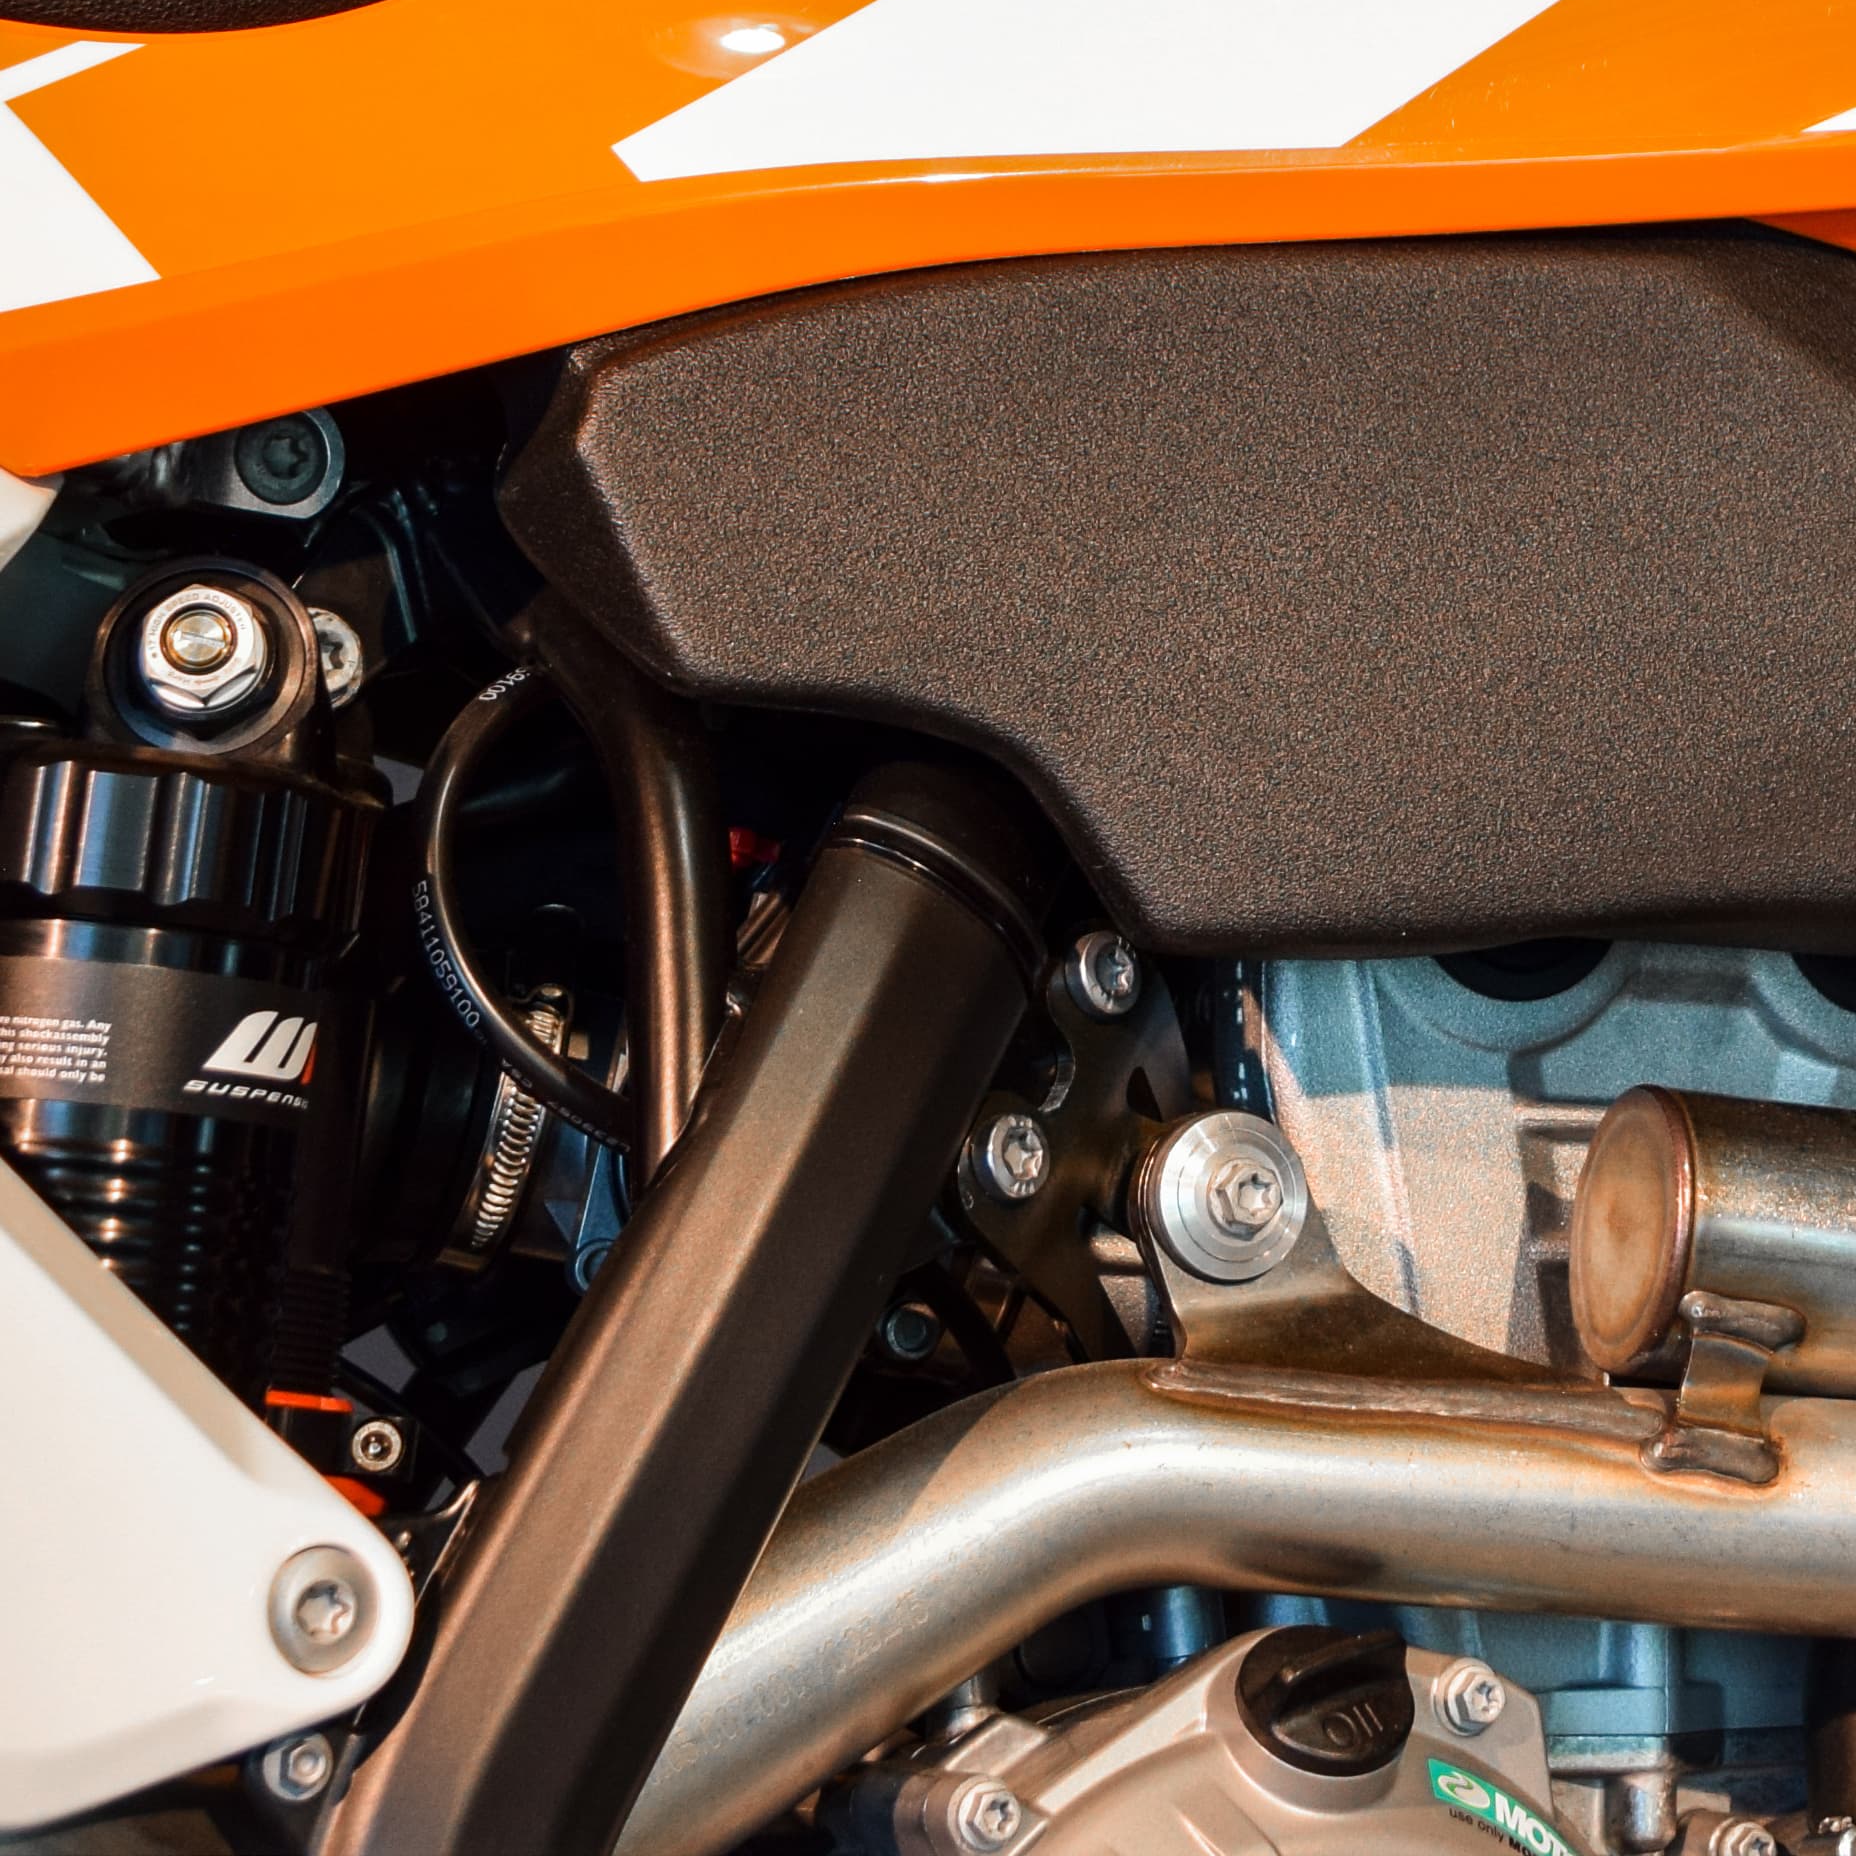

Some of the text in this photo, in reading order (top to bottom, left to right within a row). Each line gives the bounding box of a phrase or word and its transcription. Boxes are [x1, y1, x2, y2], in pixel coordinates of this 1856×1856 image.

[86, 1019, 112, 1034] Any
[17, 1042, 62, 1053] serious
[9, 1053, 34, 1064] also
[90, 1059, 107, 1070] an
[15, 1066, 57, 1078] should
[58, 1069, 87, 1083] only
[88, 1071, 106, 1083] be
[1448, 1807, 1537, 1856] use only Mo
